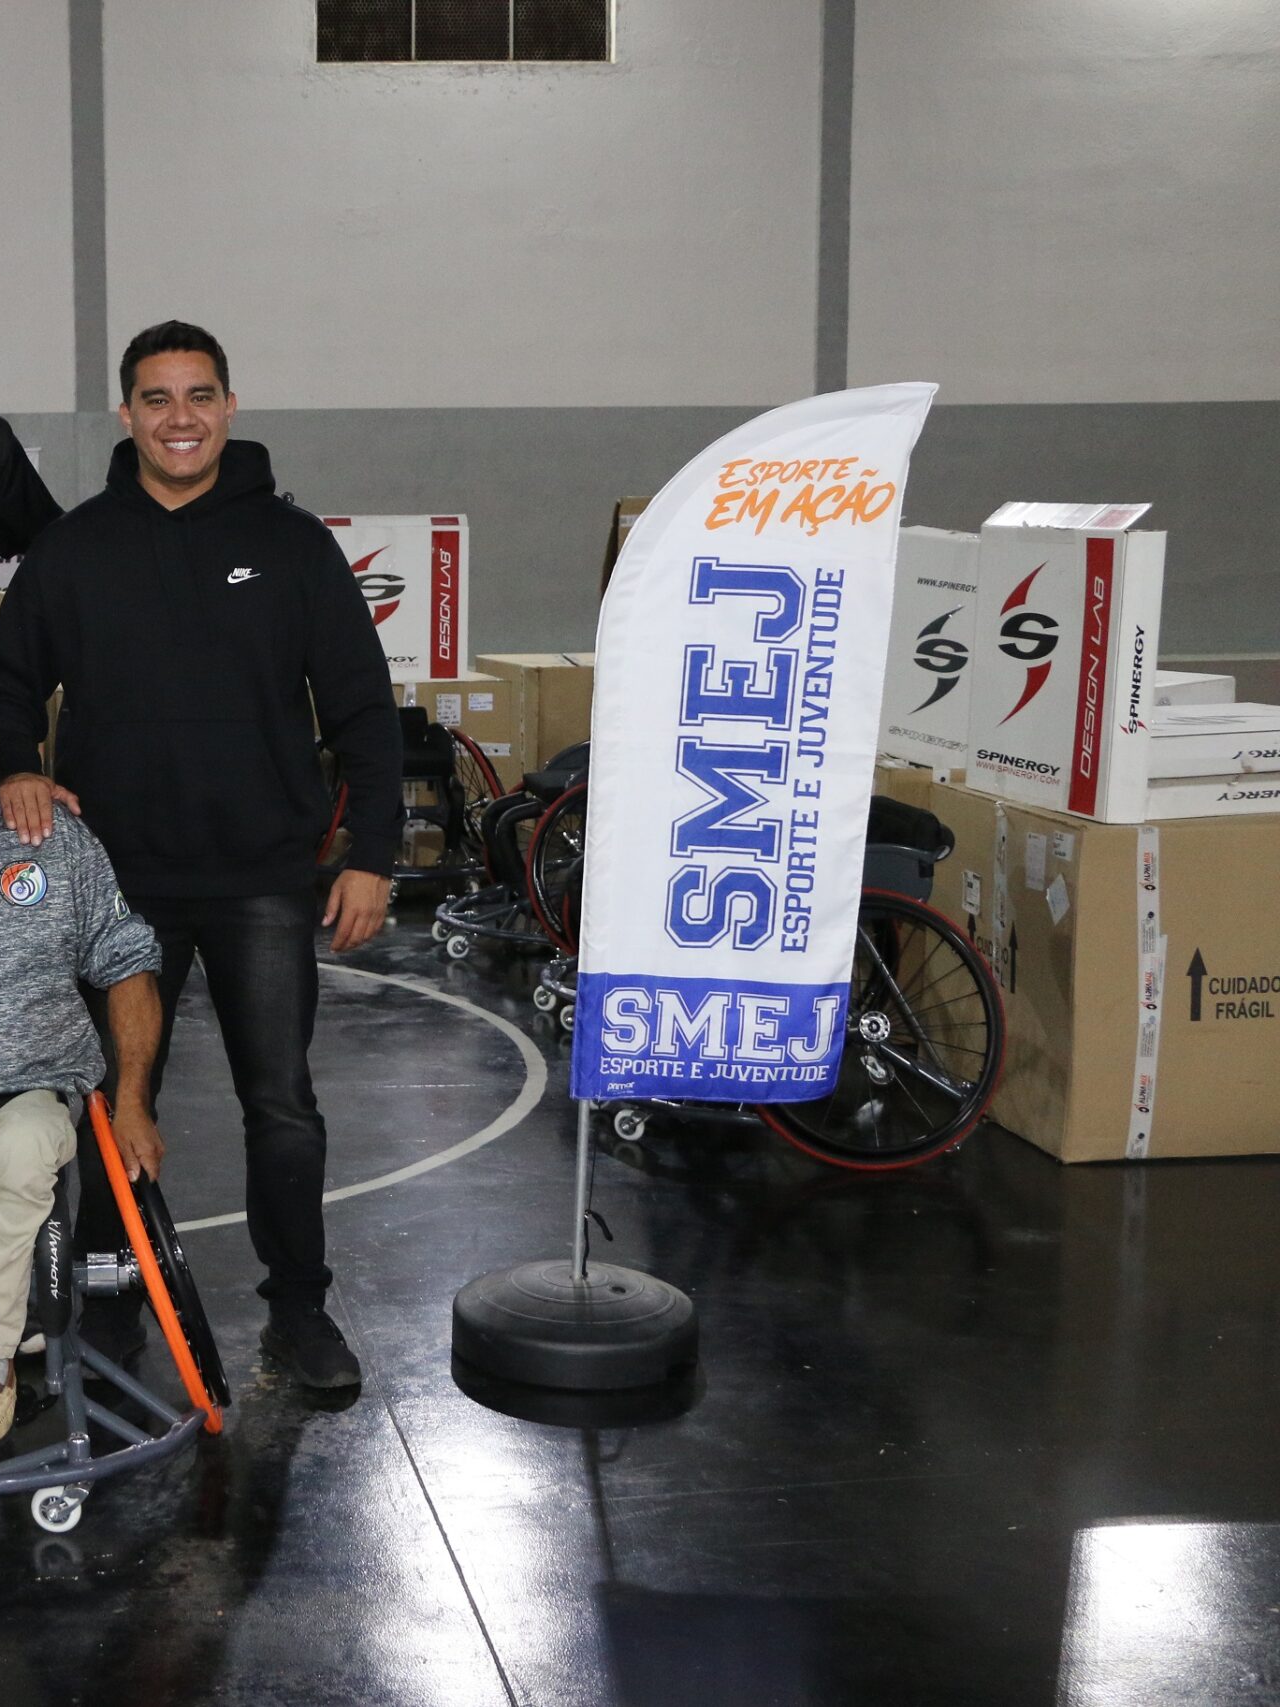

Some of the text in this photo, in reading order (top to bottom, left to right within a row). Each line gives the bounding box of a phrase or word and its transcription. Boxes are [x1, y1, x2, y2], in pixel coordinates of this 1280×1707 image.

[718, 457, 859, 489] ESPORTE
[704, 468, 896, 537] EM AÇÃO
[232, 567, 253, 577] NIKE
[916, 577, 977, 594] WWW.SPINERGY.
[439, 550, 452, 660] DESIGN LAB
[1080, 576, 1105, 780] DESIGN LAB
[1128, 625, 1145, 734] SPINERGY
[664, 556, 807, 951] SMEJ
[780, 567, 845, 953] ESPORTE E JUVENTUDE
[975, 760, 1062, 786] WWW.SPINERGY.COM
[976, 749, 1061, 777] SPINERGY
[1209, 976, 1280, 995] CUIDADO
[1216, 998, 1275, 1020] FRÁGIL
[600, 986, 840, 1065] SMEJ
[600, 1056, 830, 1083] ESPORTE E JUVENTUDE
[48, 1219, 62, 1300] ALPHAMIX
